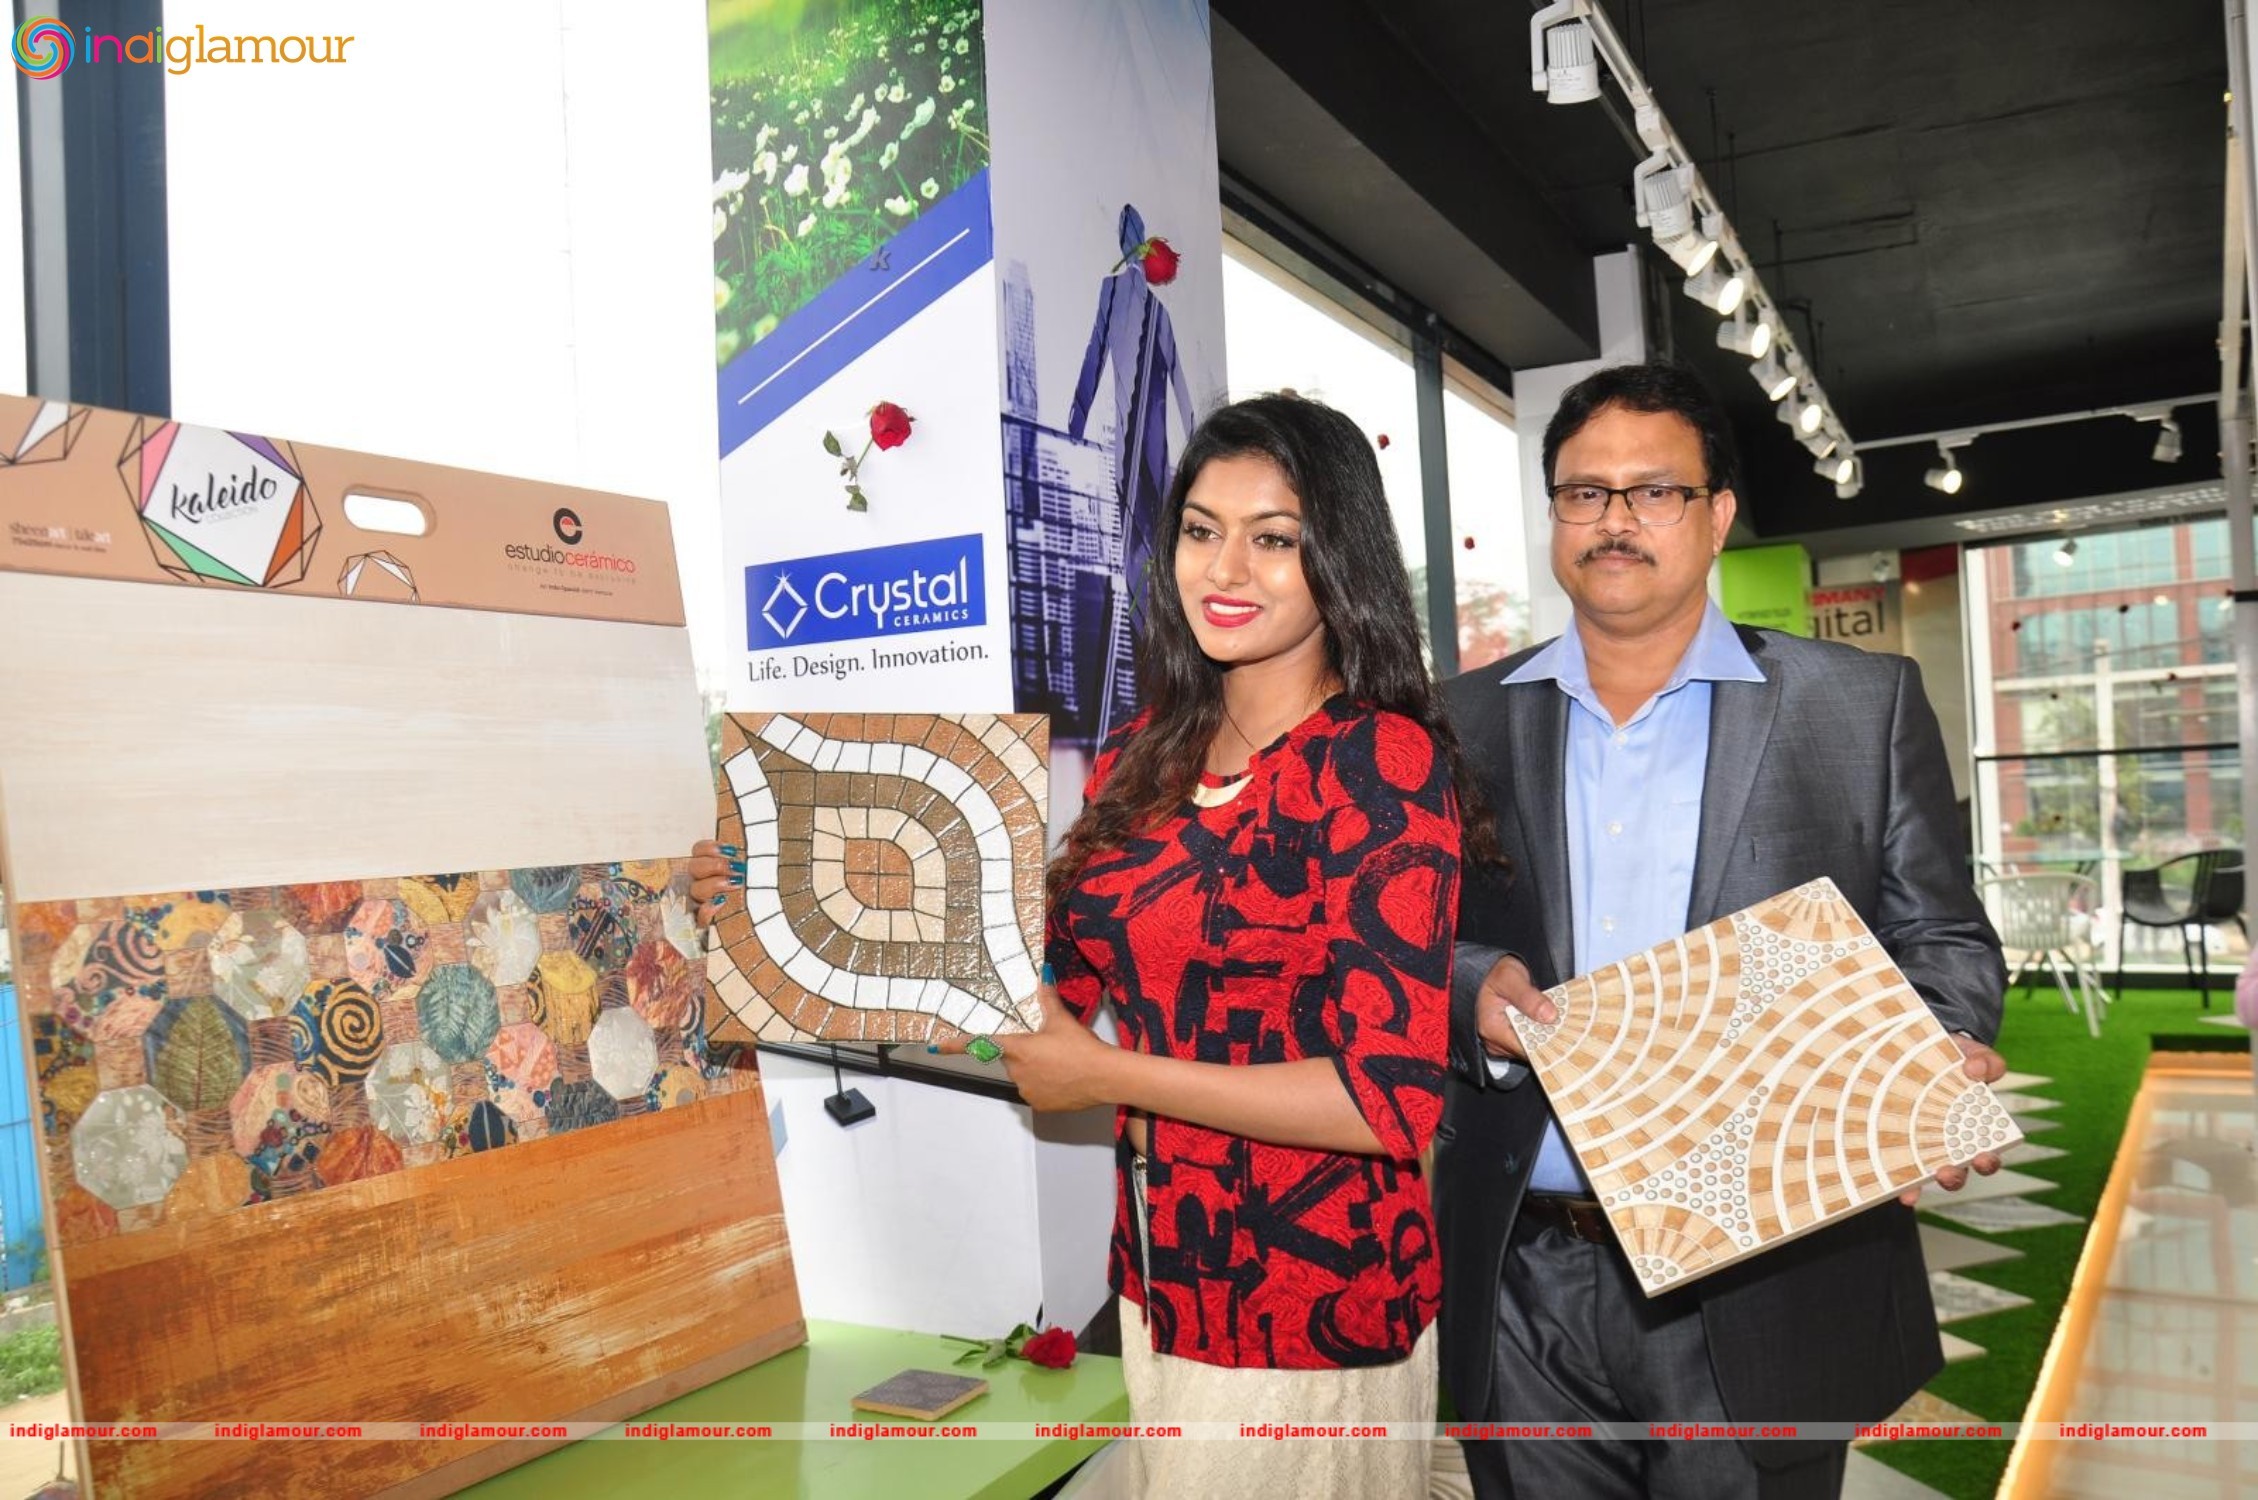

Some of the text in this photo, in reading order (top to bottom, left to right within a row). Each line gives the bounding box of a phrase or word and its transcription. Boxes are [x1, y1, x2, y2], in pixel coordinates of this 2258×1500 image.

[171, 464, 277, 524] kaleido
[814, 555, 968, 630] Crystal
[893, 608, 969, 628] CERAMICS
[748, 641, 989, 683] Life. Design. Innovation.
